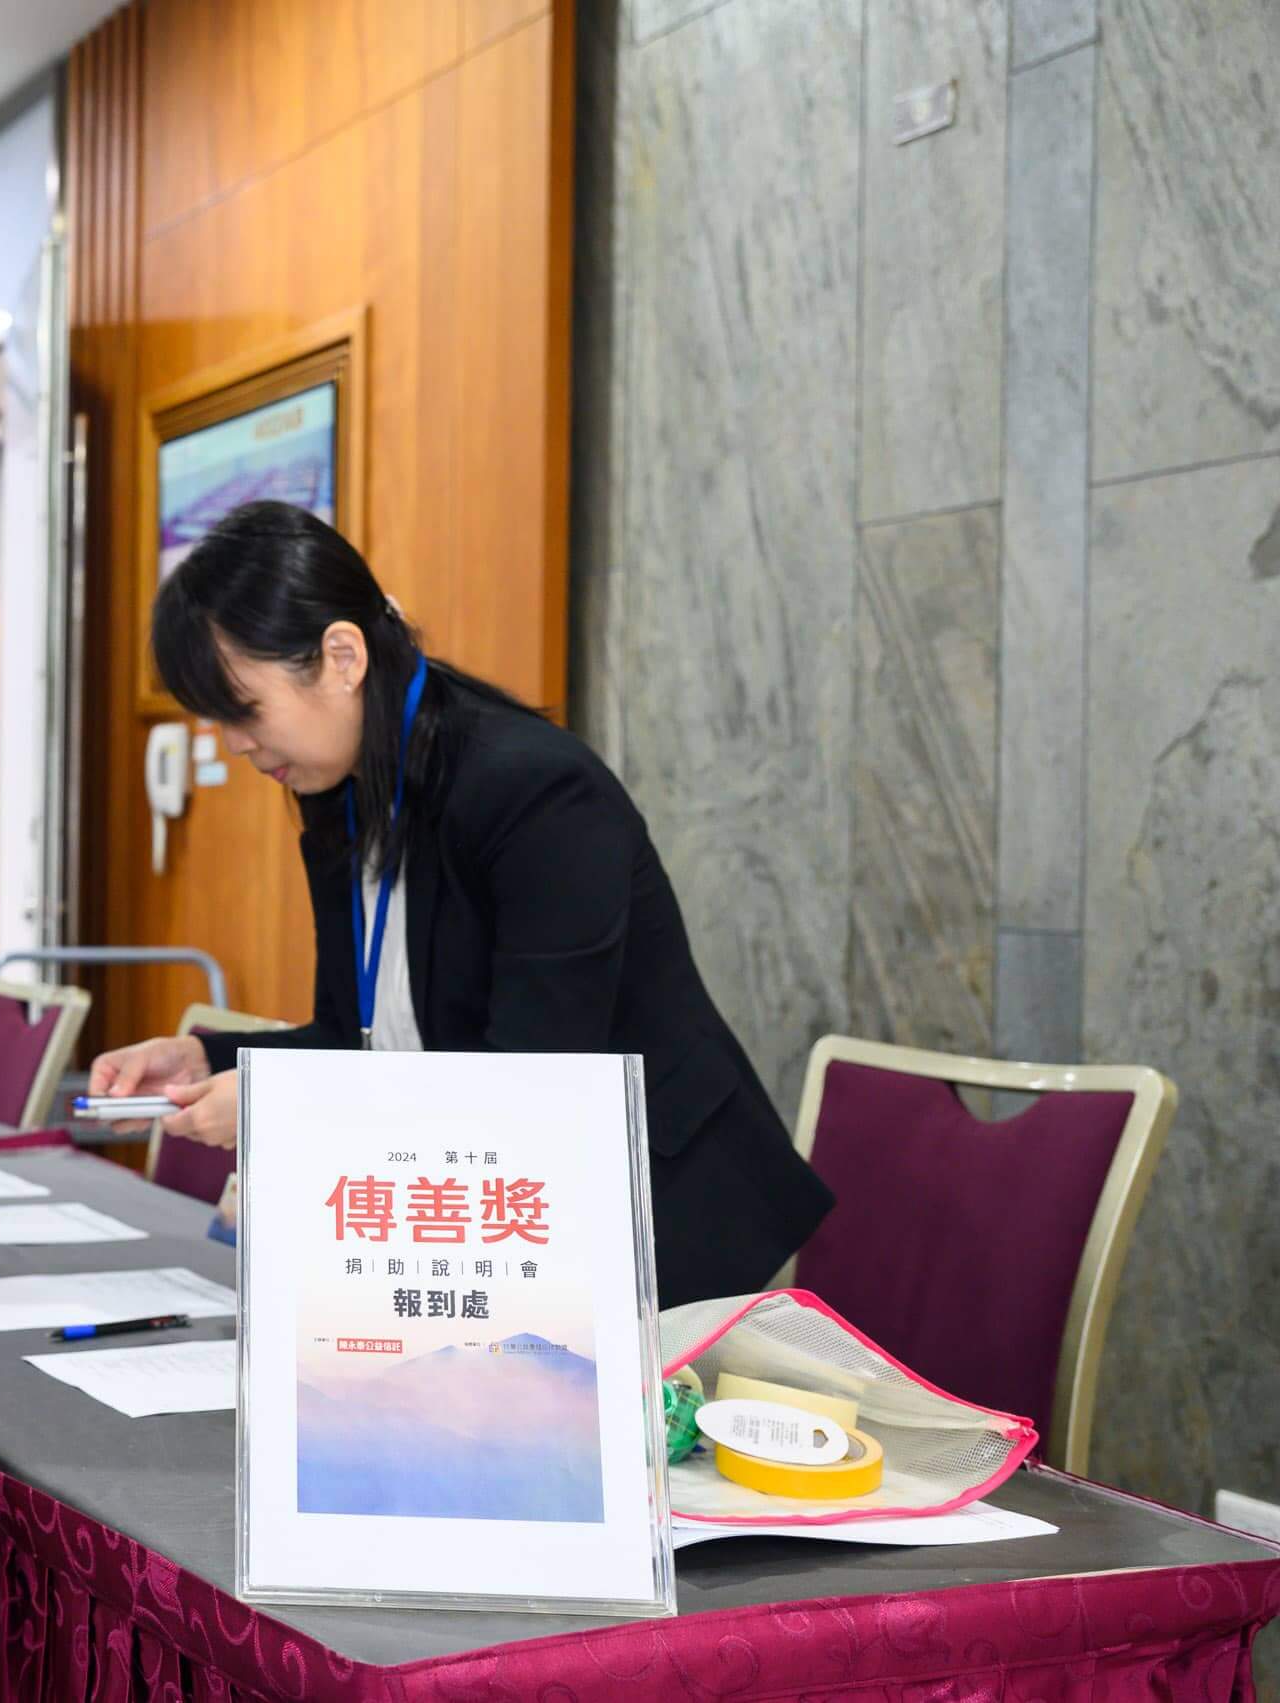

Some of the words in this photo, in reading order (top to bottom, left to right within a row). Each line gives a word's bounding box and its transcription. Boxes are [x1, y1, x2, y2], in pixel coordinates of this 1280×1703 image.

[387, 1151, 417, 1162] 2024
[444, 1150, 498, 1165] 第十屆
[324, 1174, 550, 1245] 傳善獎
[392, 1287, 490, 1320] 報到處
